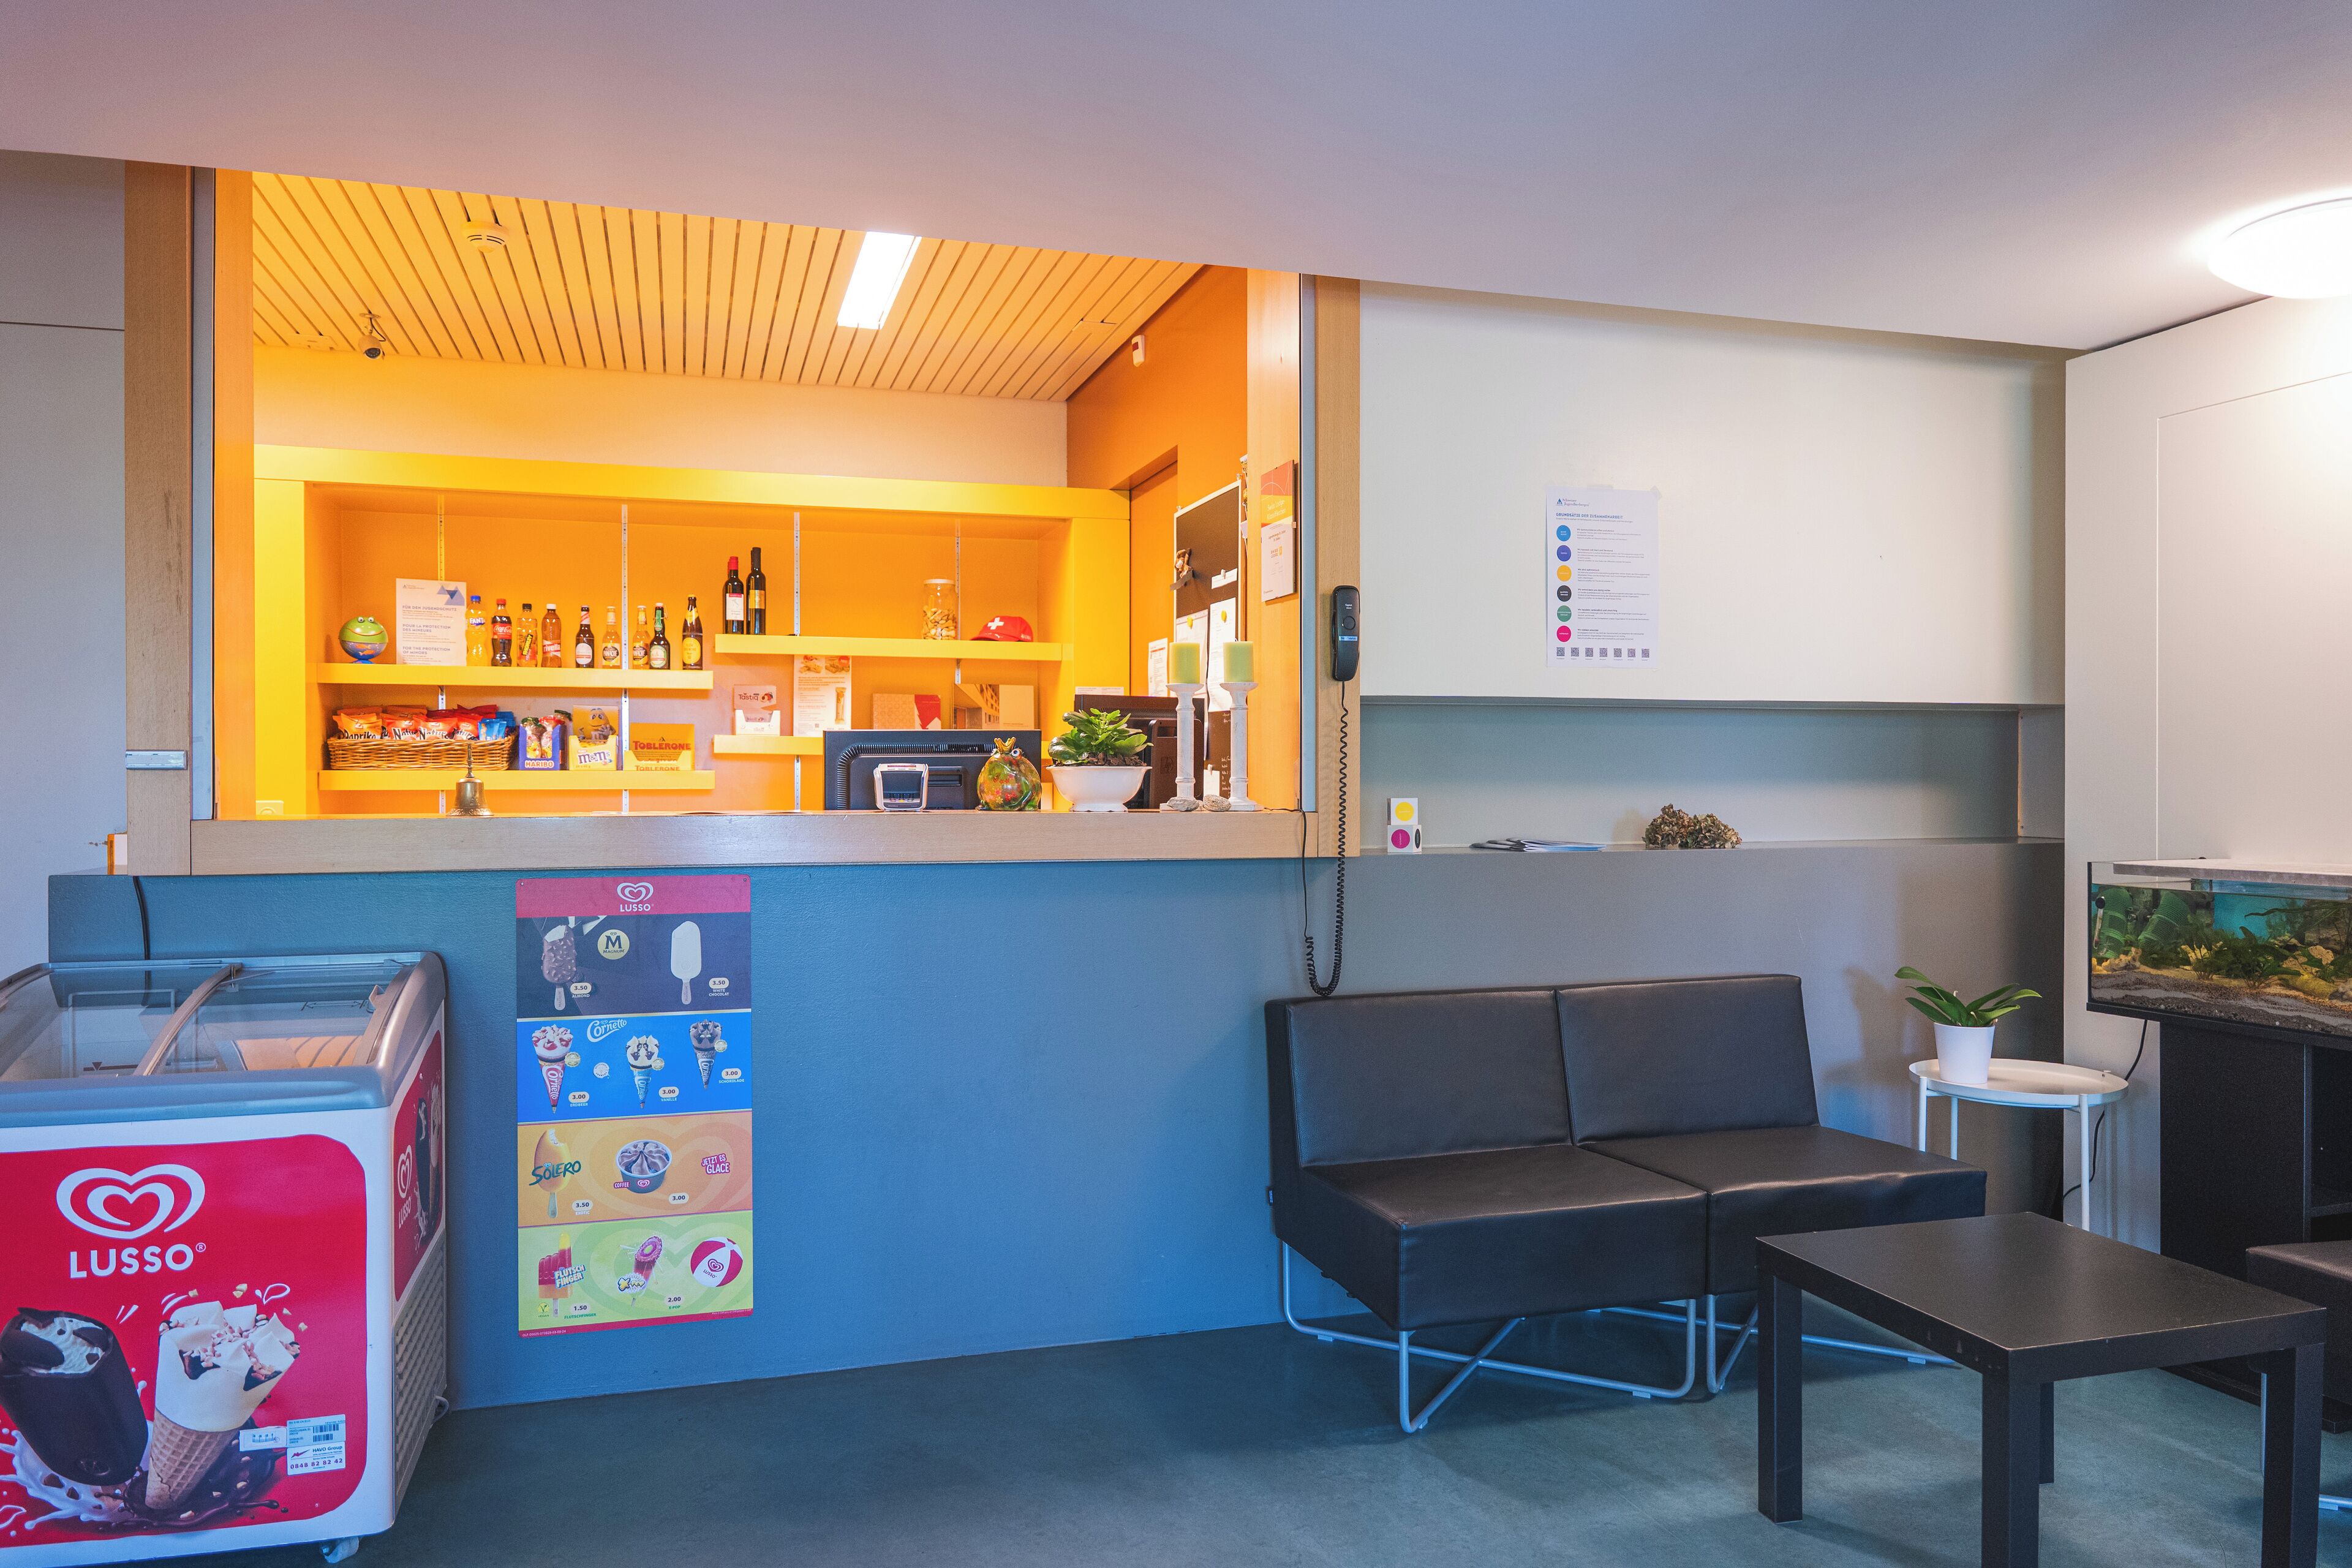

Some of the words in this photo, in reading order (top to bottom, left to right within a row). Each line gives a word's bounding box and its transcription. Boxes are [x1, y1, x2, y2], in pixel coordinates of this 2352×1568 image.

[544, 643, 560, 652] rivella
[633, 741, 692, 751] TOBLERONE
[605, 935, 622, 949] M
[587, 1019, 627, 1042] Cornetto
[542, 1065, 564, 1100] Cornetto
[702, 1156, 717, 1166] JETZT
[529, 1160, 582, 1186] SOLERO
[706, 1163, 729, 1174] GLACE
[398, 1196, 412, 1229] LUSSO
[554, 1264, 585, 1280] FLUTSCH
[703, 1269, 716, 1278] LUSSO
[556, 1273, 584, 1287] FINGER
